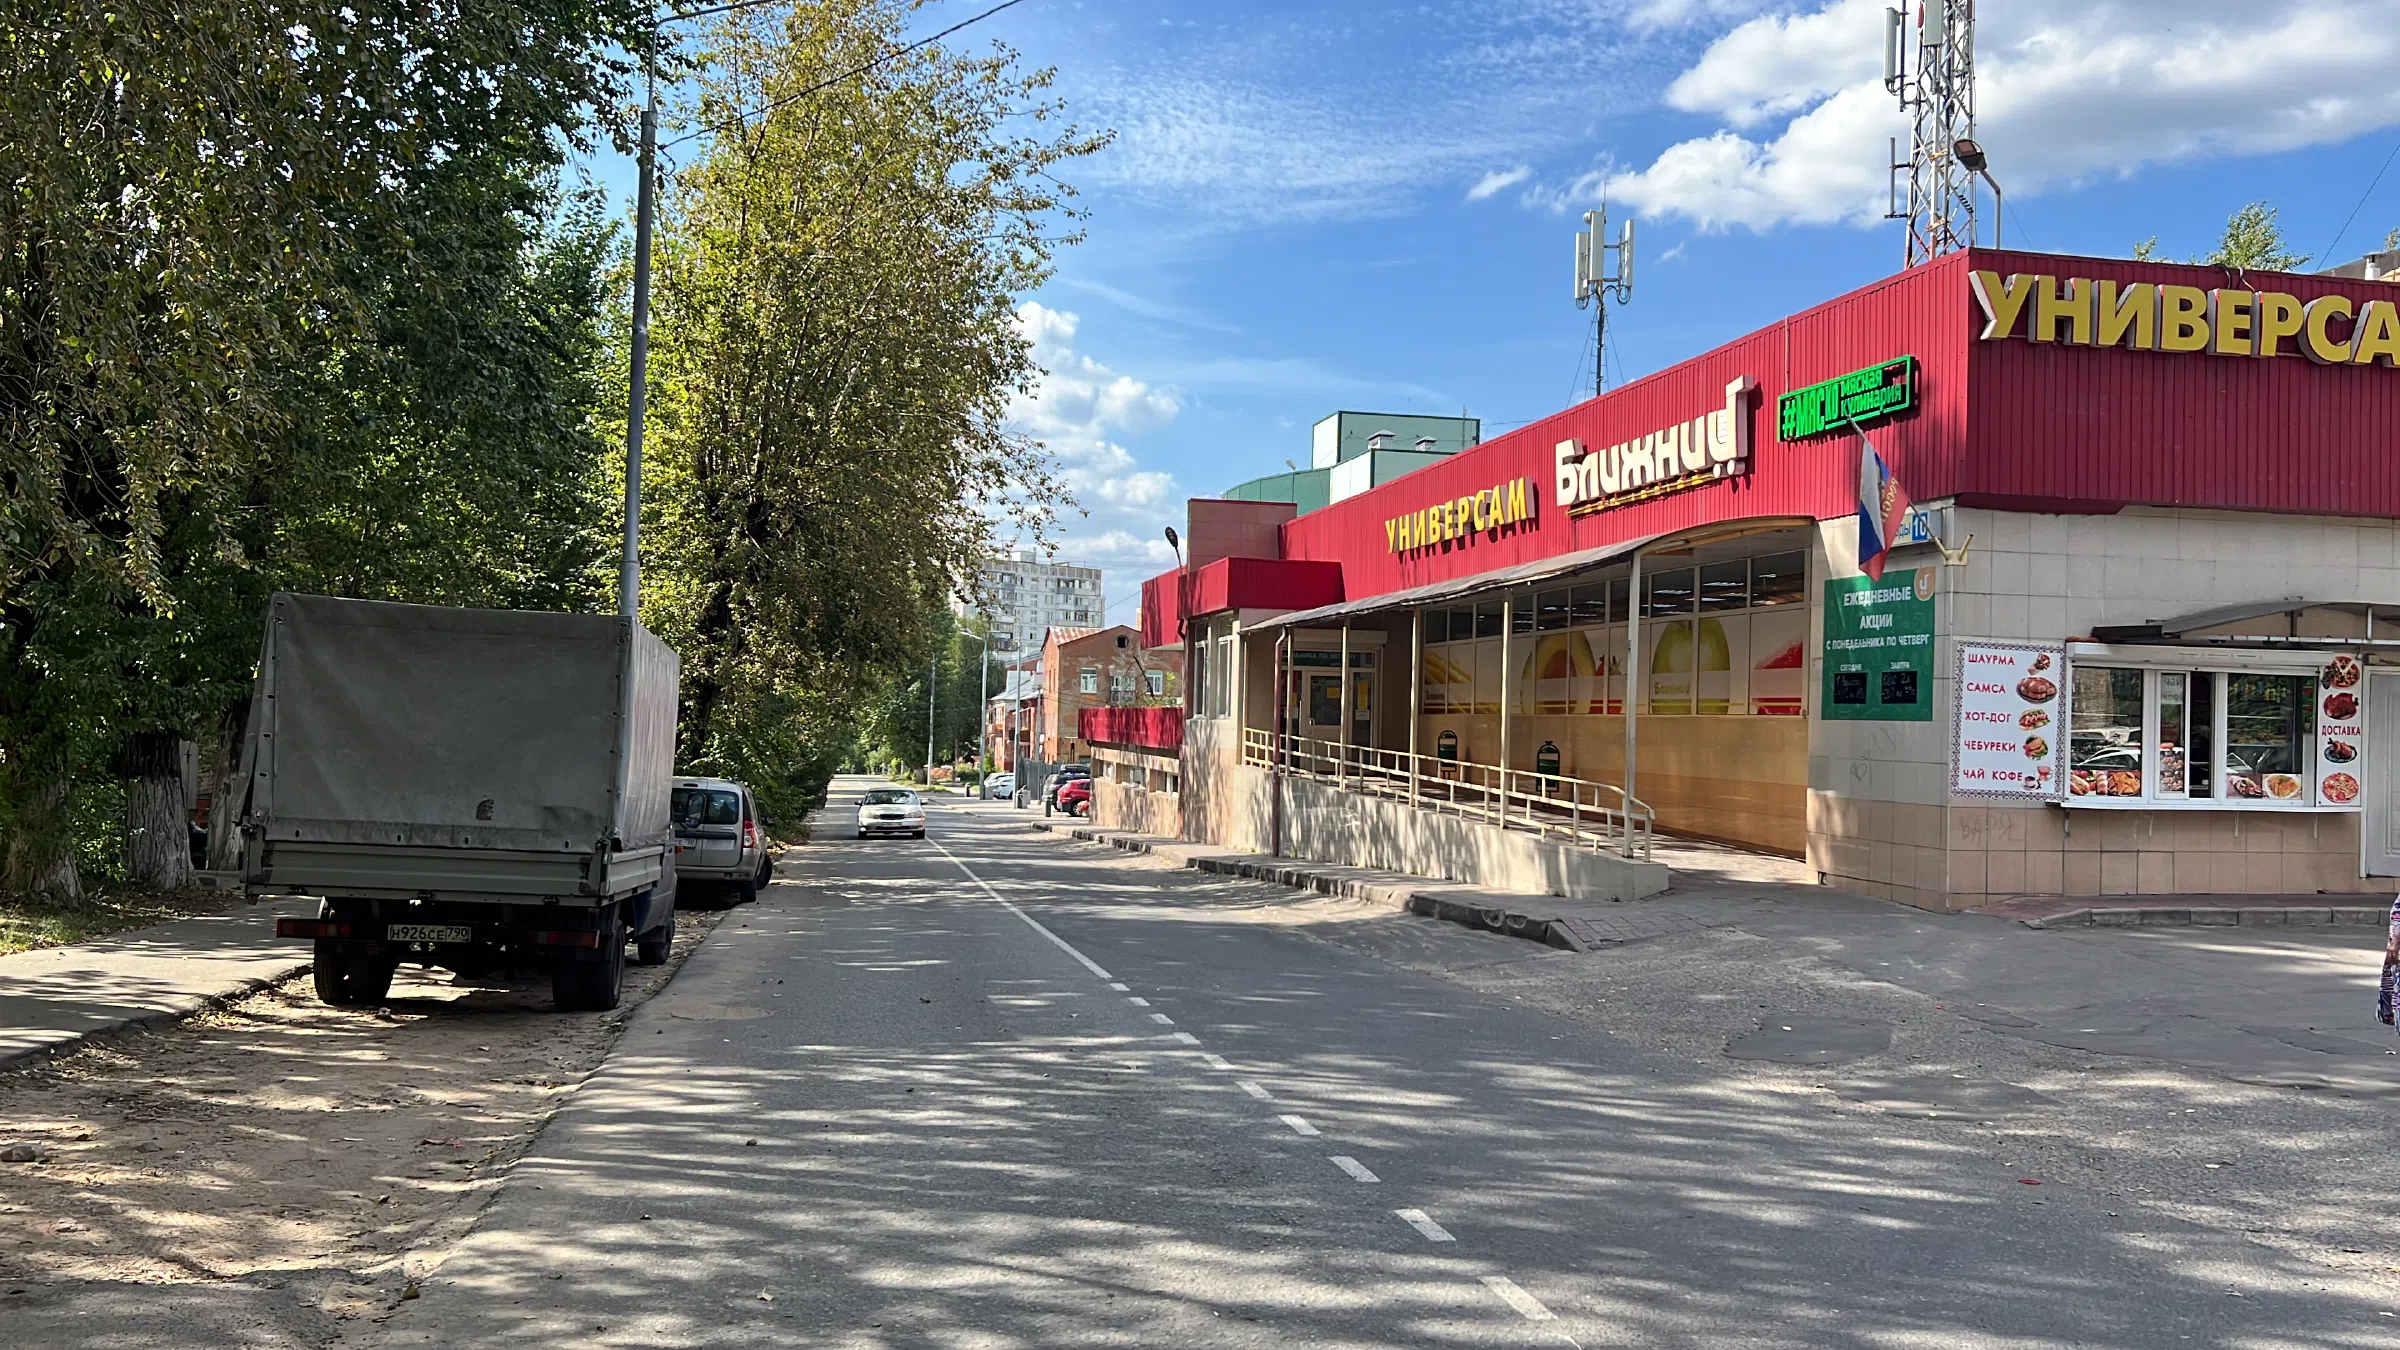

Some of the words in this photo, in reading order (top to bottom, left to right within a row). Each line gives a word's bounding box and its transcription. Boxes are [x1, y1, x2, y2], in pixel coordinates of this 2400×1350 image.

[1969, 269, 2400, 364] УНИВЕРСА
[1783, 383, 1839, 438] #МЯСКО
[1555, 375, 1747, 507] Ближний
[1385, 477, 1529, 554] УНИВЕРСАМ
[1913, 515, 1927, 537] 10
[1843, 586, 1912, 607] ЕЖЕДНЕВНЫЕ
[1860, 614, 1893, 630] АКЦИИ
[1826, 640, 1831, 650] С
[1832, 636, 1885, 650] ПОНЕДЕЛЬНИКА
[1886, 636, 1896, 647] ПО
[1898, 634, 1930, 646] ЧЕТВЕРГ
[1890, 661, 1910, 670] ЗАВТРА
[1968, 653, 2015, 666] ШАУРМА
[1966, 682, 2006, 694] САМСА
[1965, 711, 2011, 724] ХОТ-ДОГ
[2321, 725, 2361, 736] ДОСТАВКА
[1964, 740, 2016, 752] ЧЕБУРЕКИ
[1963, 768, 1985, 780] ЧАЙ
[1992, 770, 2023, 781] КОФЕ
